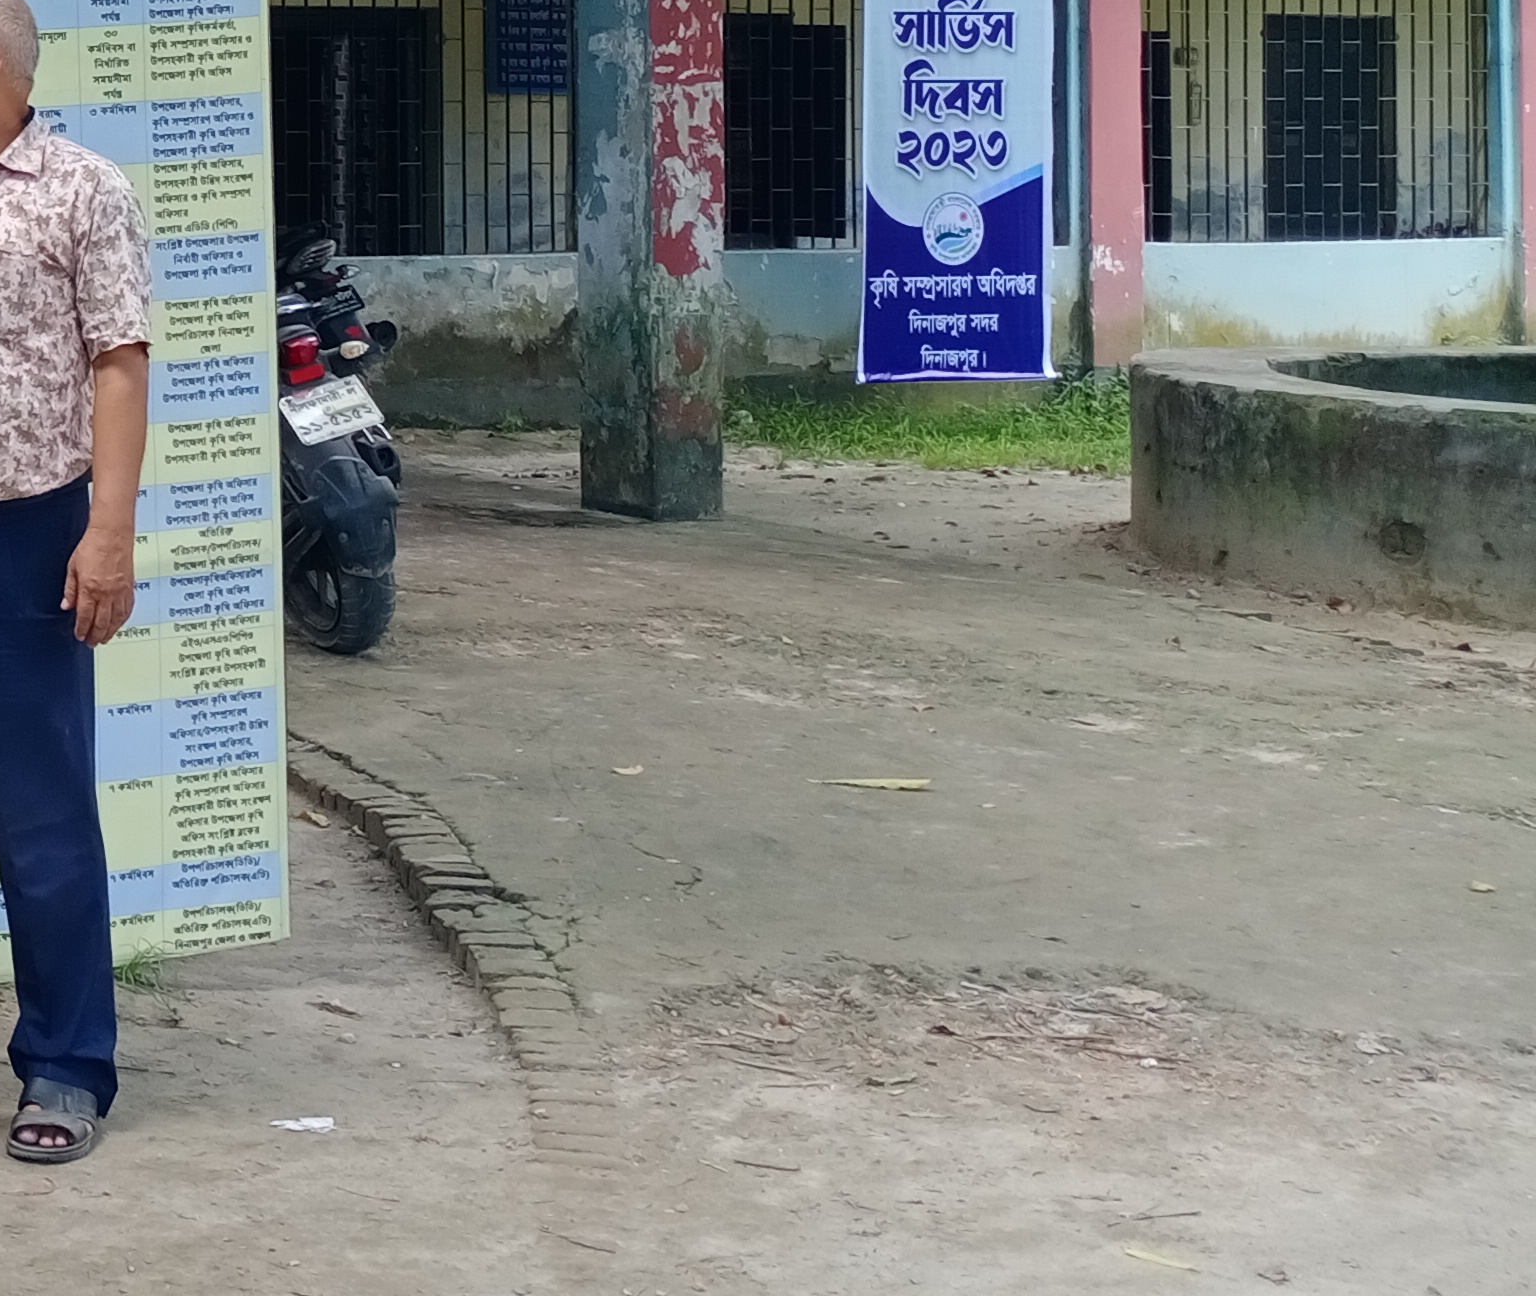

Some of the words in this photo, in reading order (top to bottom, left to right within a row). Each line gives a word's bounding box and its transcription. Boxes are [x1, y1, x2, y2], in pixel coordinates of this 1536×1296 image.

[900, 58, 1007, 122] দিবস
[895, 128, 1009, 180] ২০২৩
[868, 269, 899, 309] কৃষি
[904, 271, 973, 300] সম্প্রসারণ
[977, 268, 1037, 297] অধিদপ্তর
[908, 309, 966, 338] দিনাজপুর
[970, 313, 999, 333] সদর
